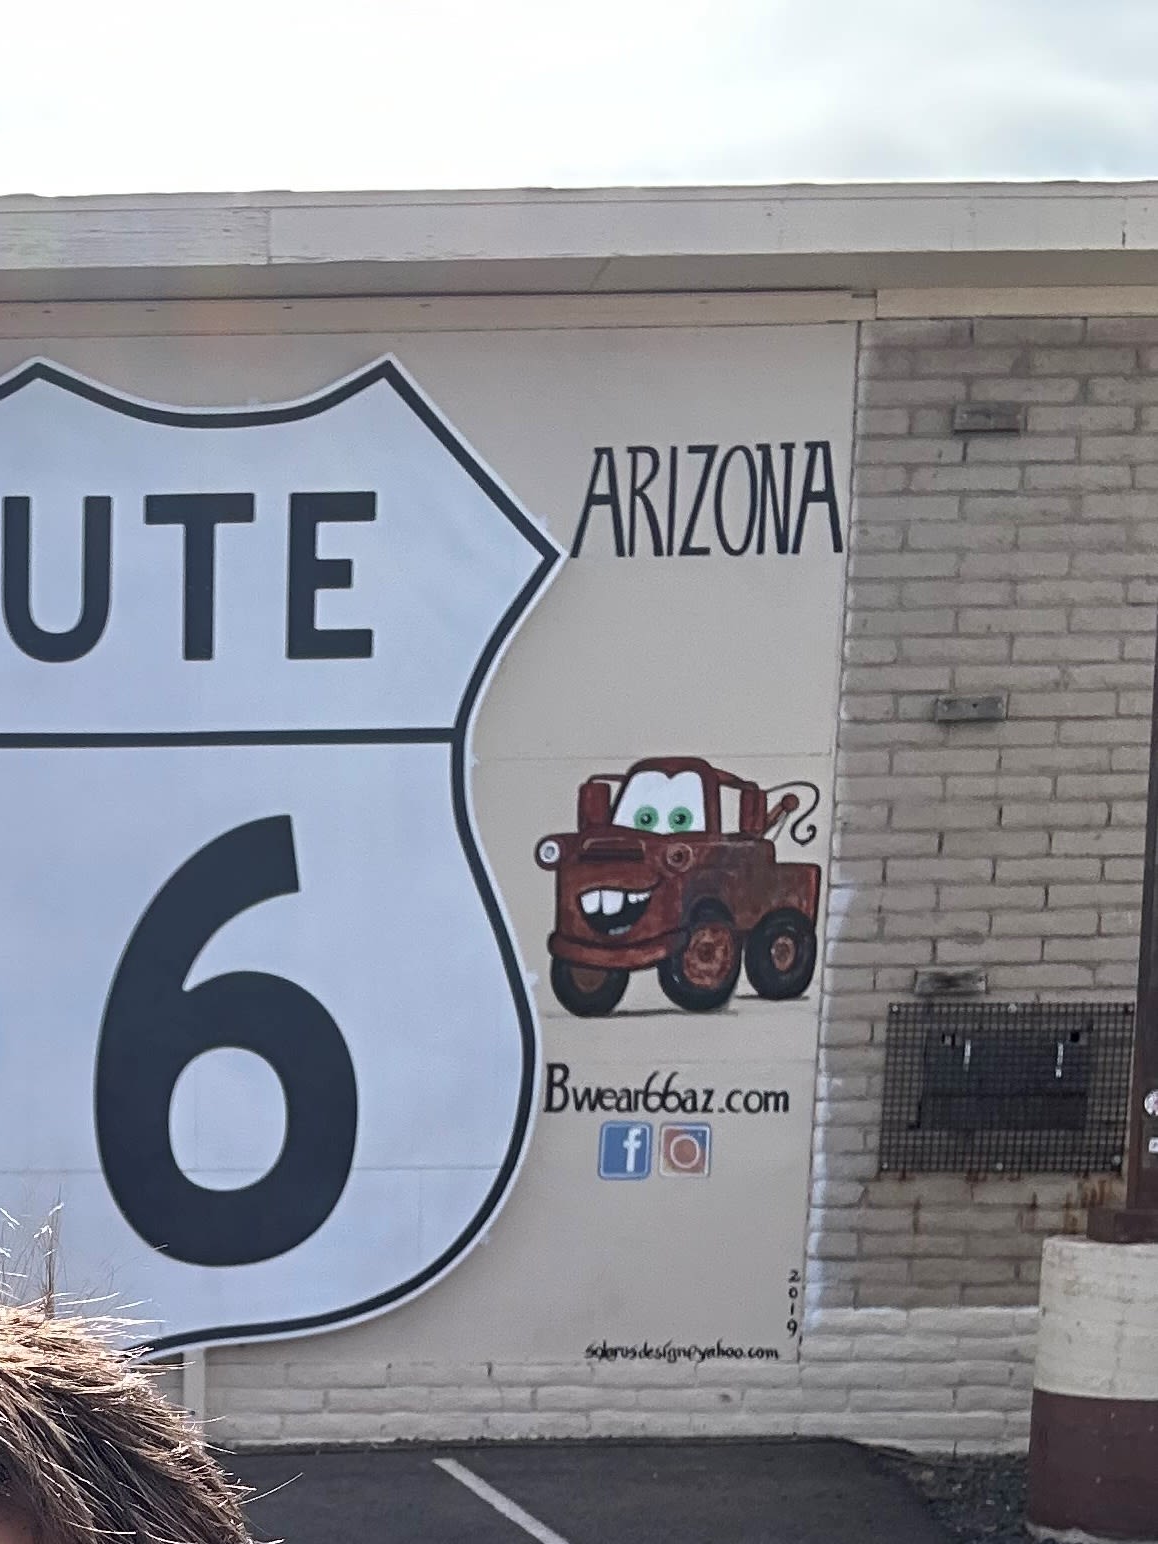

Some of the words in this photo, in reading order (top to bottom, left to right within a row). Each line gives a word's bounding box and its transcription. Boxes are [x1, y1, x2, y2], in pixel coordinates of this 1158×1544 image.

[570, 440, 844, 558] ARIZONA
[543, 1062, 790, 1115] Bwear66az.com
[786, 1268, 802, 1339] 2019
